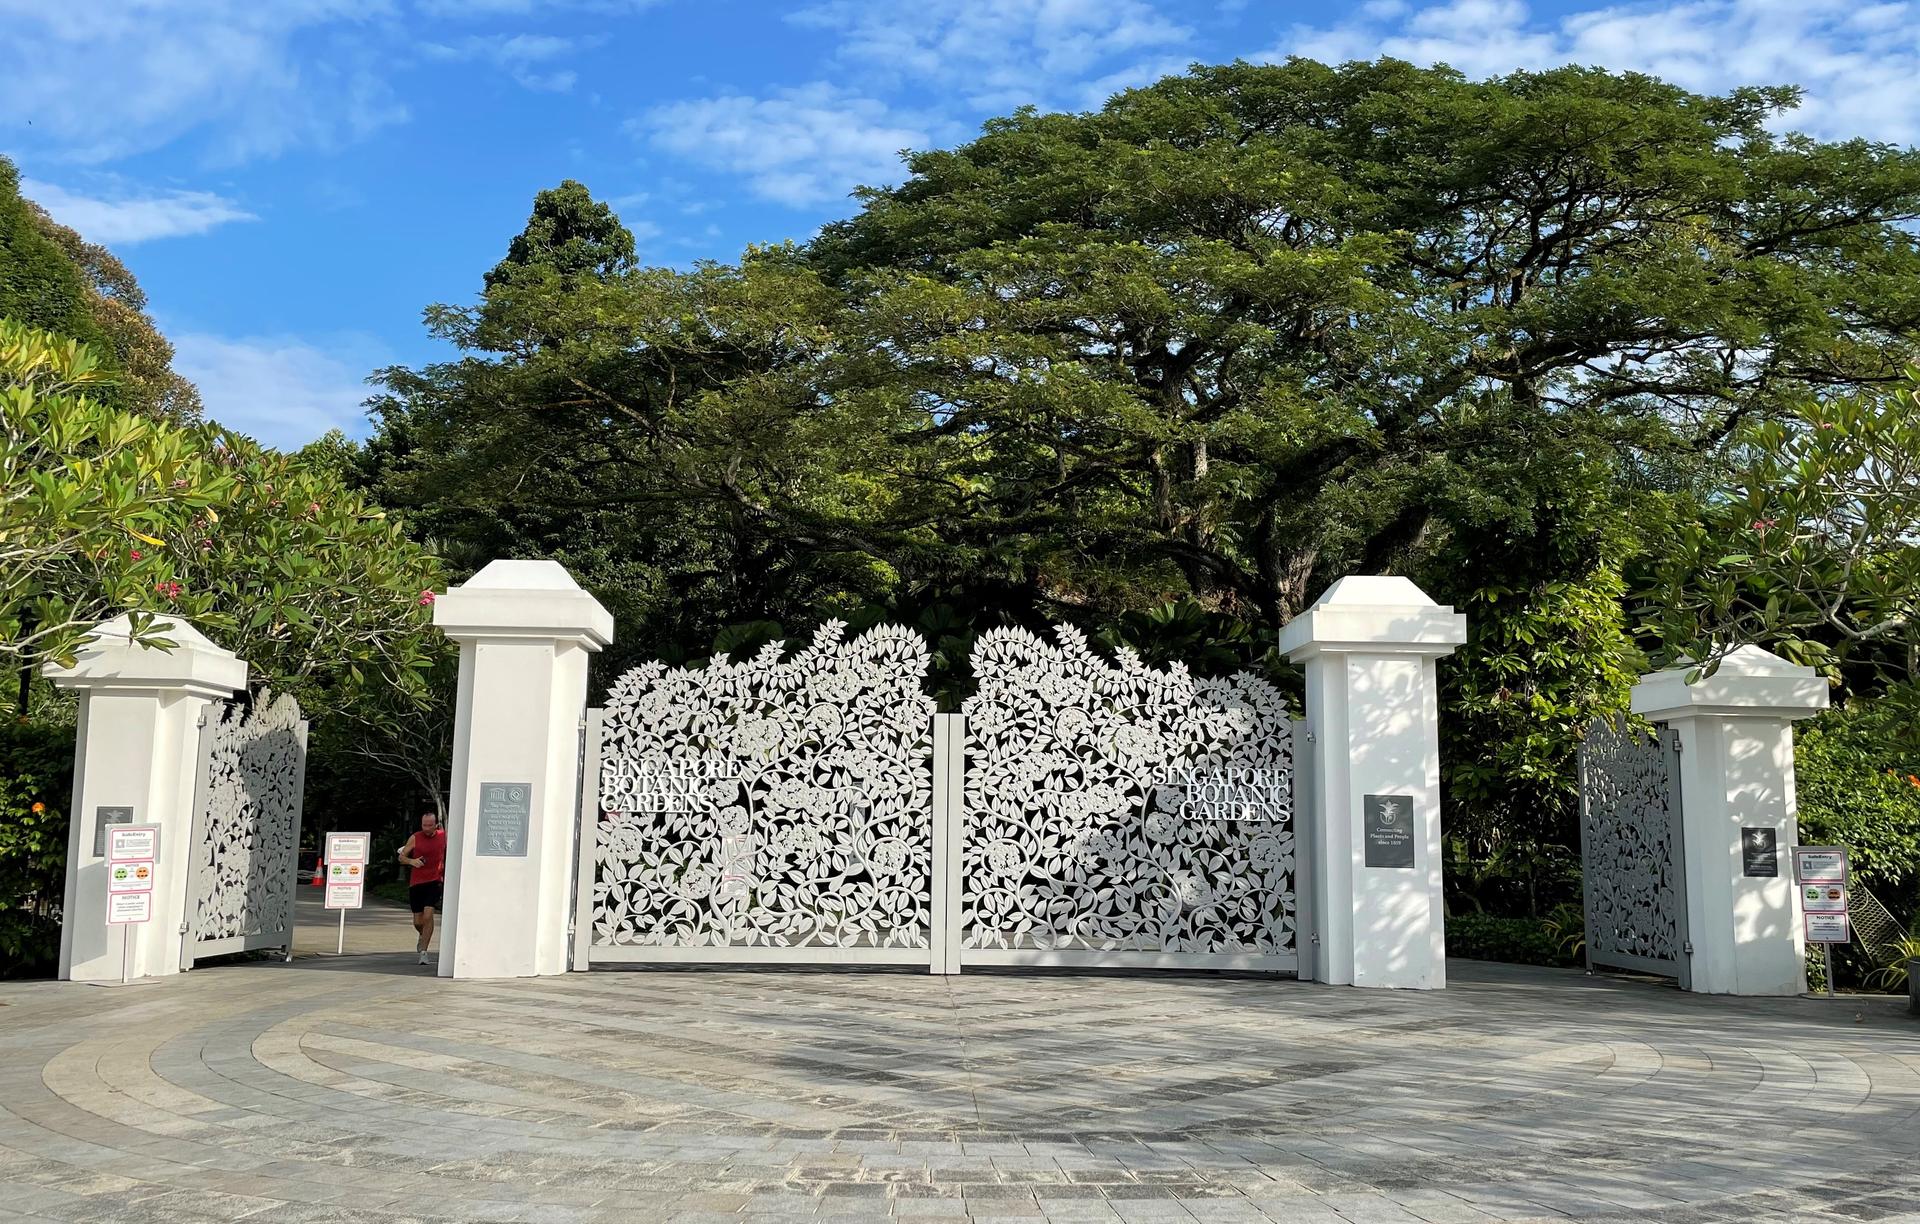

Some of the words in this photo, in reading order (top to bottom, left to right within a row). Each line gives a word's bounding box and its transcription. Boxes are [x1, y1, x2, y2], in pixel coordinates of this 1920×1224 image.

[602, 758, 742, 778] SINGAPORE
[1152, 766, 1290, 787] SINGAPORE
[603, 776, 710, 795] BOTANIC
[1186, 784, 1291, 804] BOTANIC
[601, 794, 714, 812] GARDENS
[1180, 802, 1291, 822] GARDENS
